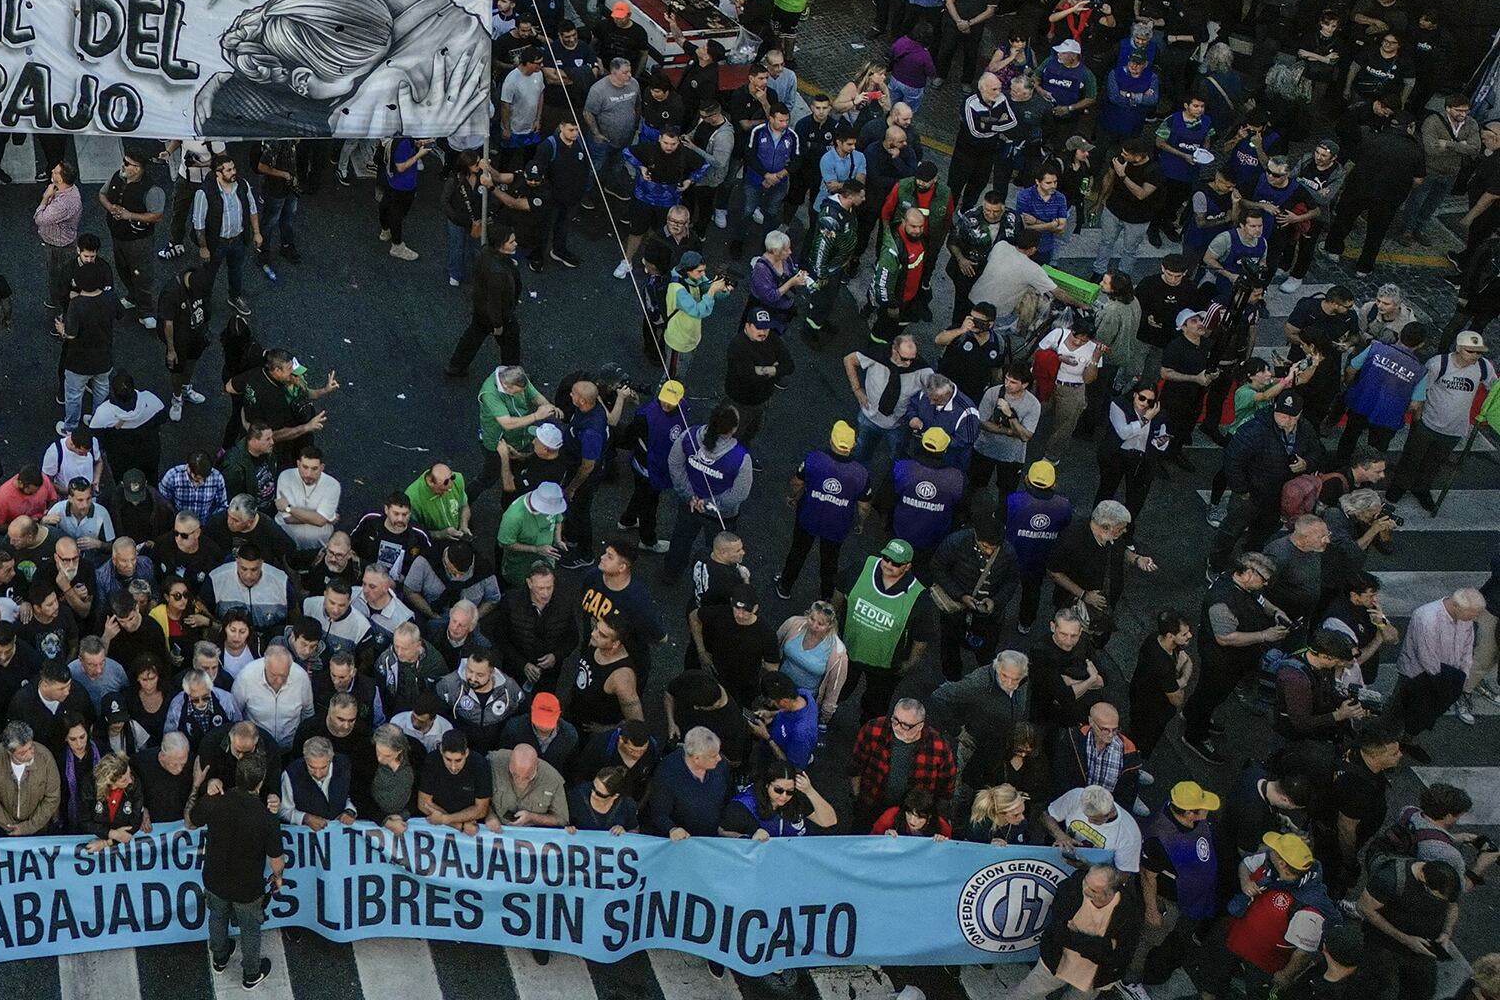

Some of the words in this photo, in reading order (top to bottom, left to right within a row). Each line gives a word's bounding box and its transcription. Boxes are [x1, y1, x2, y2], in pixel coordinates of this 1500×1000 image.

[854, 598, 895, 629] FEDUN
[73, 826, 209, 878] SINDICA
[281, 831, 334, 874] SIN
[347, 826, 648, 894] TRABAJADORES,
[316, 873, 484, 931] LIBRES
[501, 890, 585, 939] SIN
[602, 892, 858, 966] SINDICATO
[962, 865, 1006, 946] CONFEDERACION
[1007, 862, 1061, 888] GENERA
[981, 877, 1056, 939] CGT
